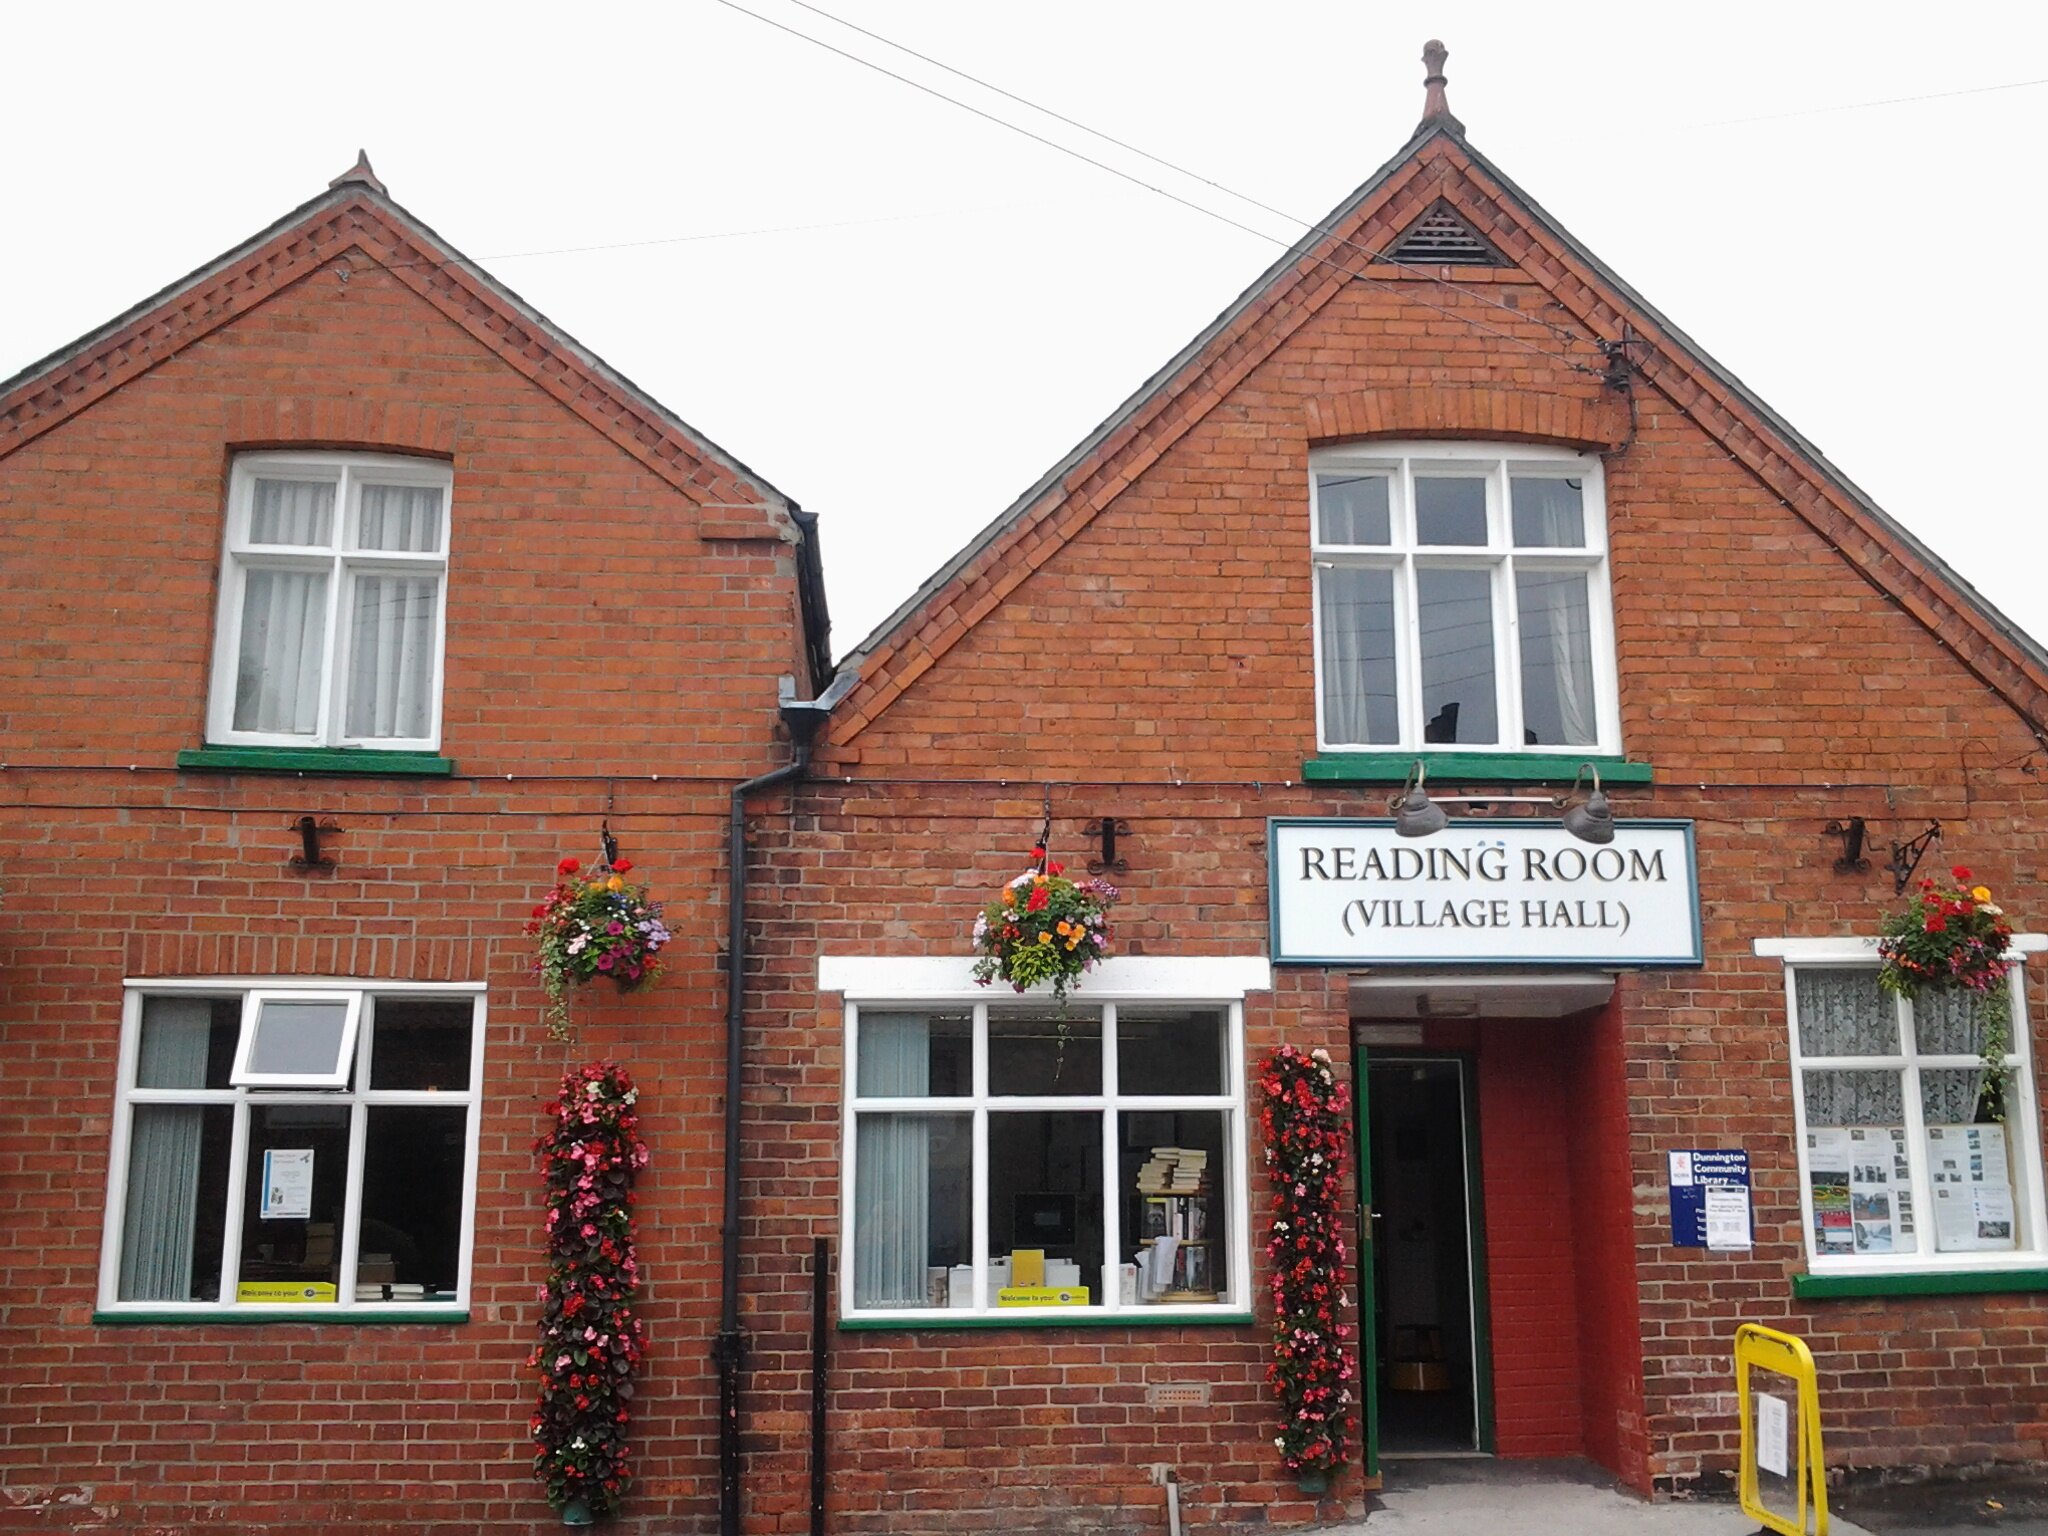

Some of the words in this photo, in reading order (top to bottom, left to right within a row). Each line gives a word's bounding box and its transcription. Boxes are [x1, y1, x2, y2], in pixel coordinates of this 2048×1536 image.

[1299, 847, 1507, 882] READING
[1522, 848, 1668, 883] ROOM
[1341, 899, 1510, 936] (VILLAGE
[1520, 900, 1631, 936] HALL)
[1693, 1153, 1746, 1163] Dunnington
[1694, 1164, 1747, 1175] Community
[1694, 1175, 1728, 1186] Library
